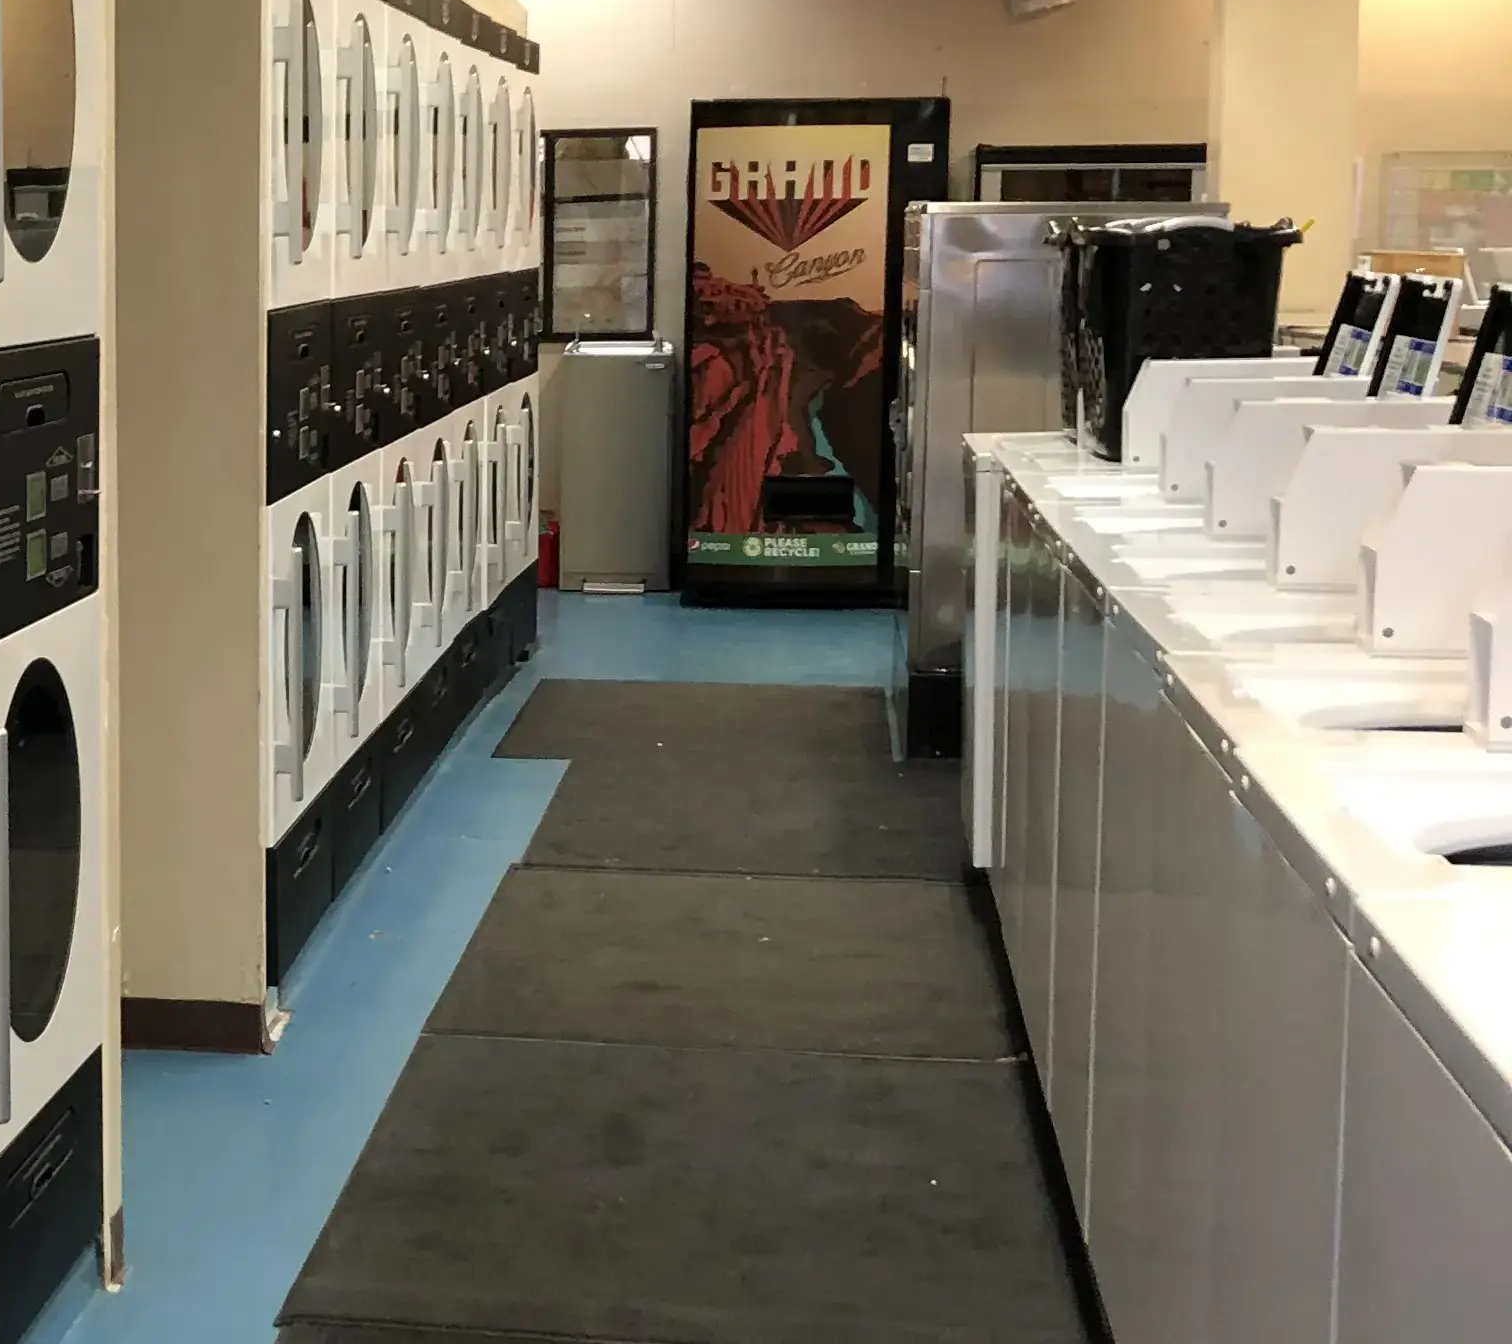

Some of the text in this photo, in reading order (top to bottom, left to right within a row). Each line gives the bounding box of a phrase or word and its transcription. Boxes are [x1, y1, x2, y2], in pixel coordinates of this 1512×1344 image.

[705, 155, 873, 200] GRAND
[765, 248, 867, 289] Canyon
[764, 537, 808, 548] PLEASE
[764, 547, 820, 558] RECYCLE!
